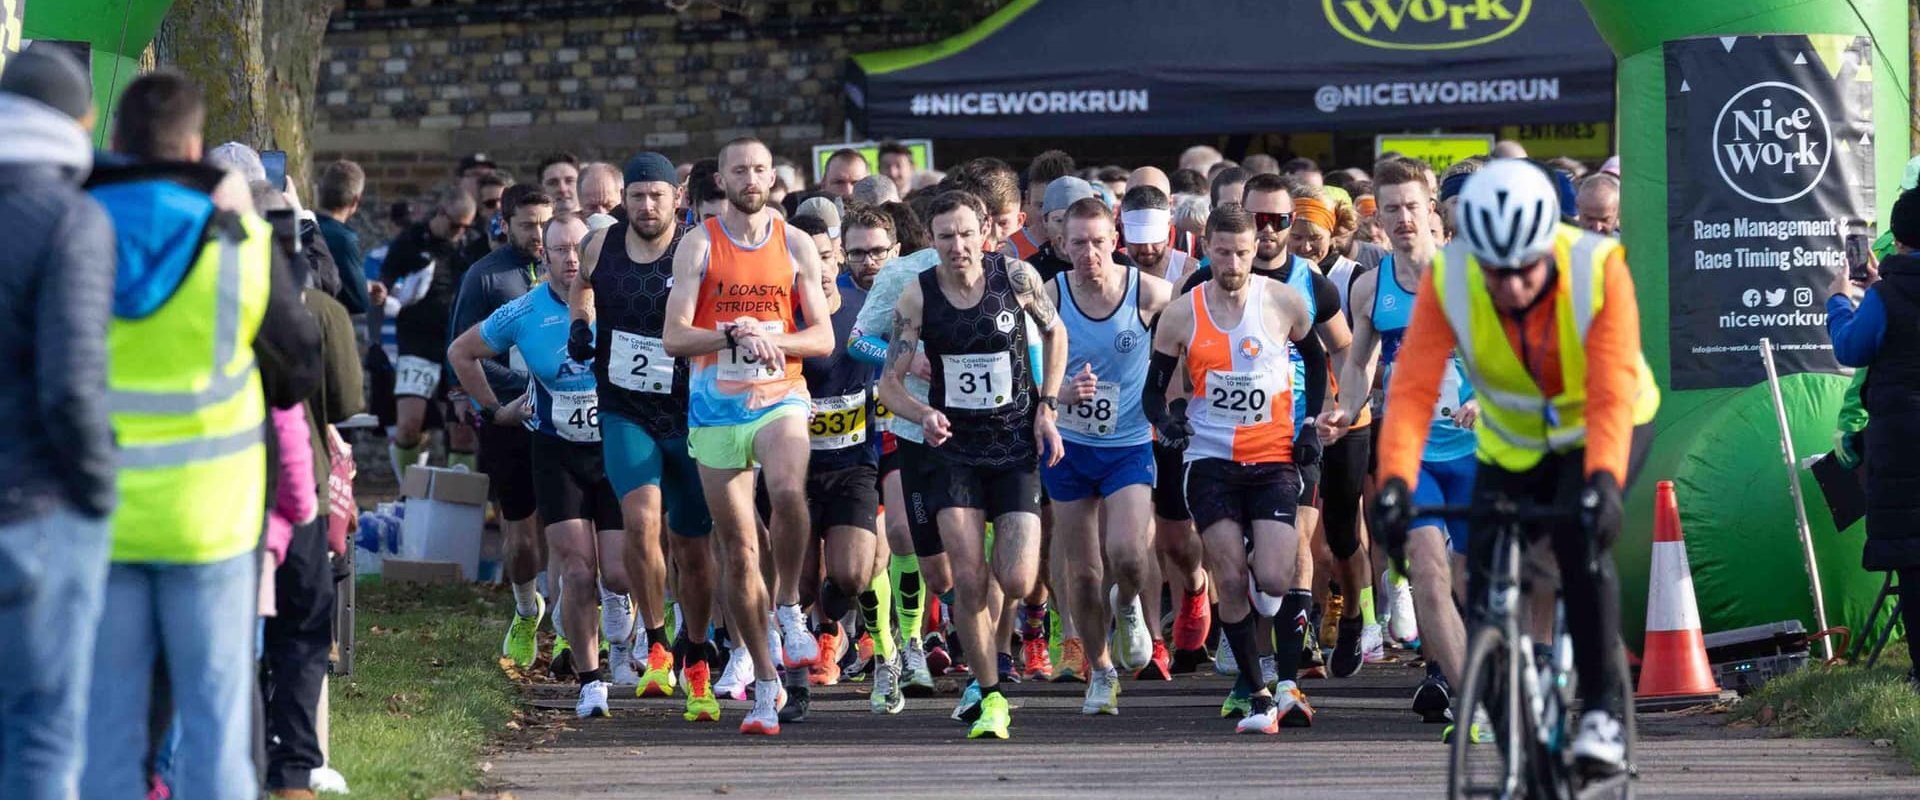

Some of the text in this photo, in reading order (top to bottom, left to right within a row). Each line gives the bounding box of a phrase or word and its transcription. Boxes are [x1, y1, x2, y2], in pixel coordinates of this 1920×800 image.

[910, 89, 1149, 115] #NICEWORKRUN
[1314, 78, 1560, 112] @NICEWORKRUN
[1732, 98, 1812, 141] Nice
[1723, 132, 1821, 174] Work
[1693, 217, 1850, 241] Race Management &
[1695, 246, 1847, 271] Race Timing Service
[729, 284, 788, 297] COASTAL
[715, 300, 780, 313] STRIDERS
[402, 368, 434, 388] 179
[630, 353, 649, 378] 2
[959, 371, 993, 395] 31
[1212, 387, 1266, 411] 220
[809, 408, 860, 435] 537
